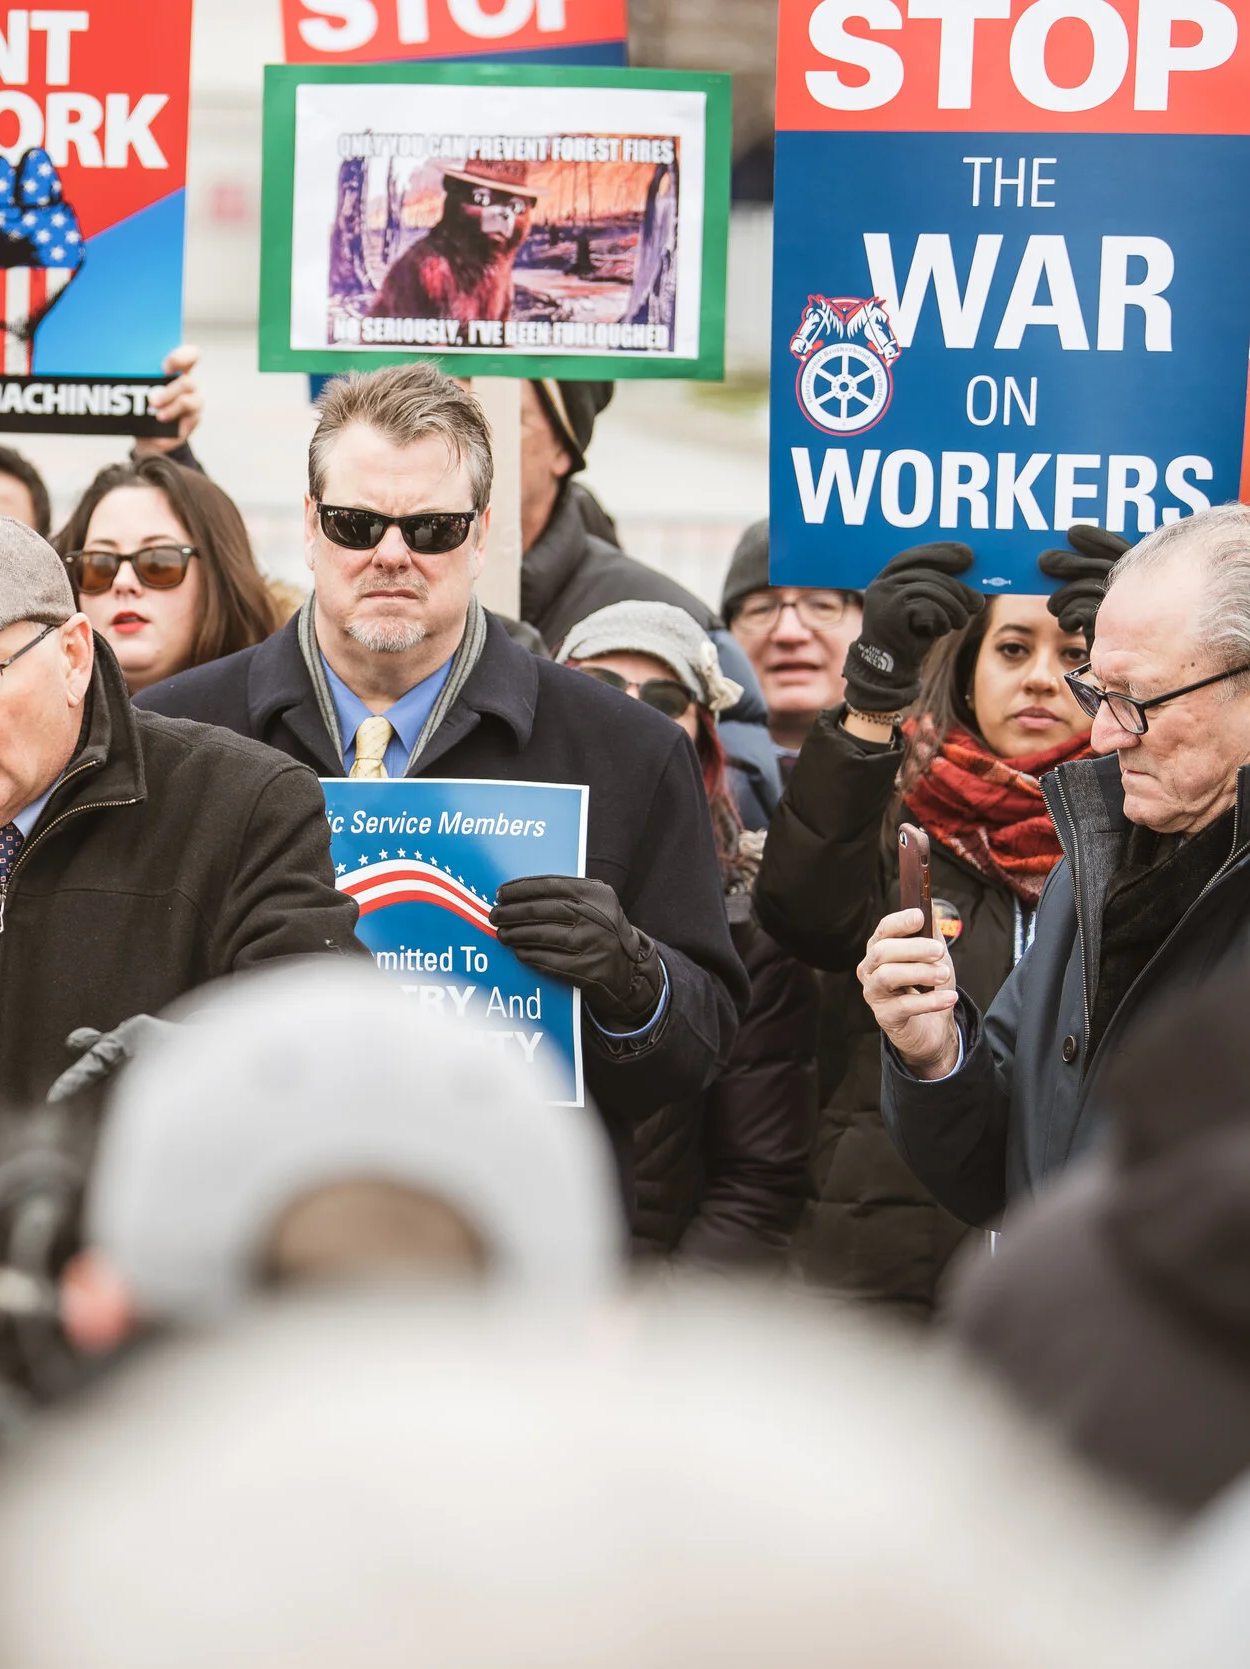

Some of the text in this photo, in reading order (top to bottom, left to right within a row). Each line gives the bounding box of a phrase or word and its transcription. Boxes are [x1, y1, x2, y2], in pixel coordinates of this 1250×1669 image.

[805, 0, 1238, 111] STOP
[427, 134, 466, 160] CAN
[467, 134, 548, 162] PREVENT
[551, 136, 620, 163] FOREST
[622, 138, 675, 165] FIRES
[963, 157, 1057, 208] THE
[863, 232, 1175, 351] WAR
[504, 320, 550, 346] BEEN
[552, 321, 670, 348] FURLOUGHED
[966, 375, 1037, 427] ON
[790, 446, 1214, 533] WORKERS
[351, 811, 431, 834] Service
[438, 811, 546, 837] Members
[376, 945, 488, 972] mitted To
[486, 987, 541, 1019] And
